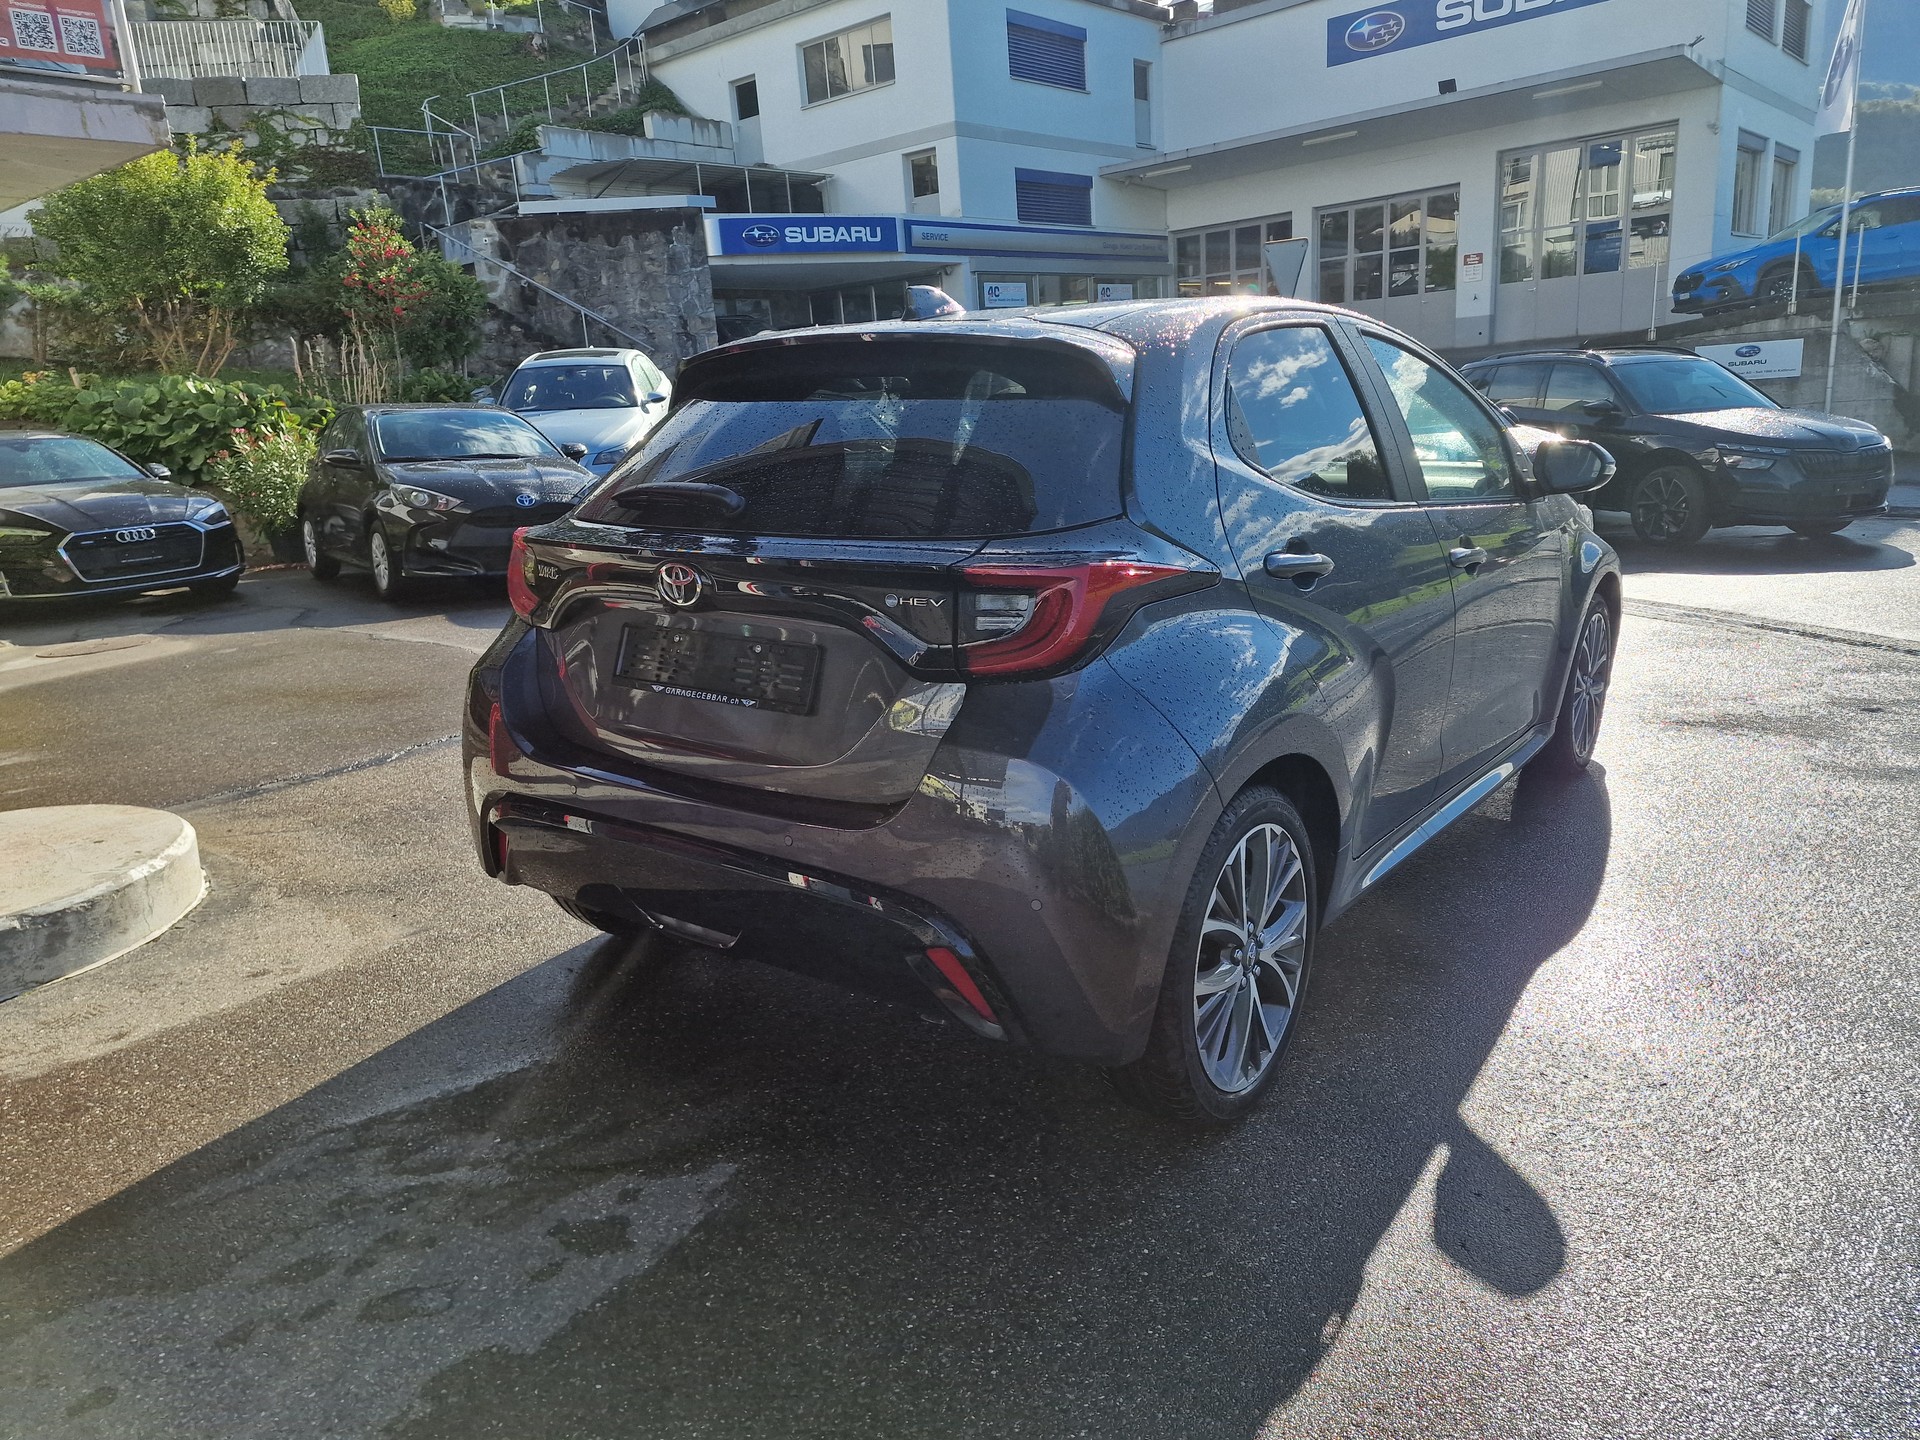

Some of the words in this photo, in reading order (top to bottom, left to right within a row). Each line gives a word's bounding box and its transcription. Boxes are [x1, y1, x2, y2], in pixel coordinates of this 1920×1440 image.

[785, 226, 882, 243] SUBARU
[921, 231, 949, 242] SERVICE
[1727, 359, 1768, 367] SUBARU
[899, 597, 947, 607] HEV
[665, 686, 740, 705] GARAGECEBBAR.ch
